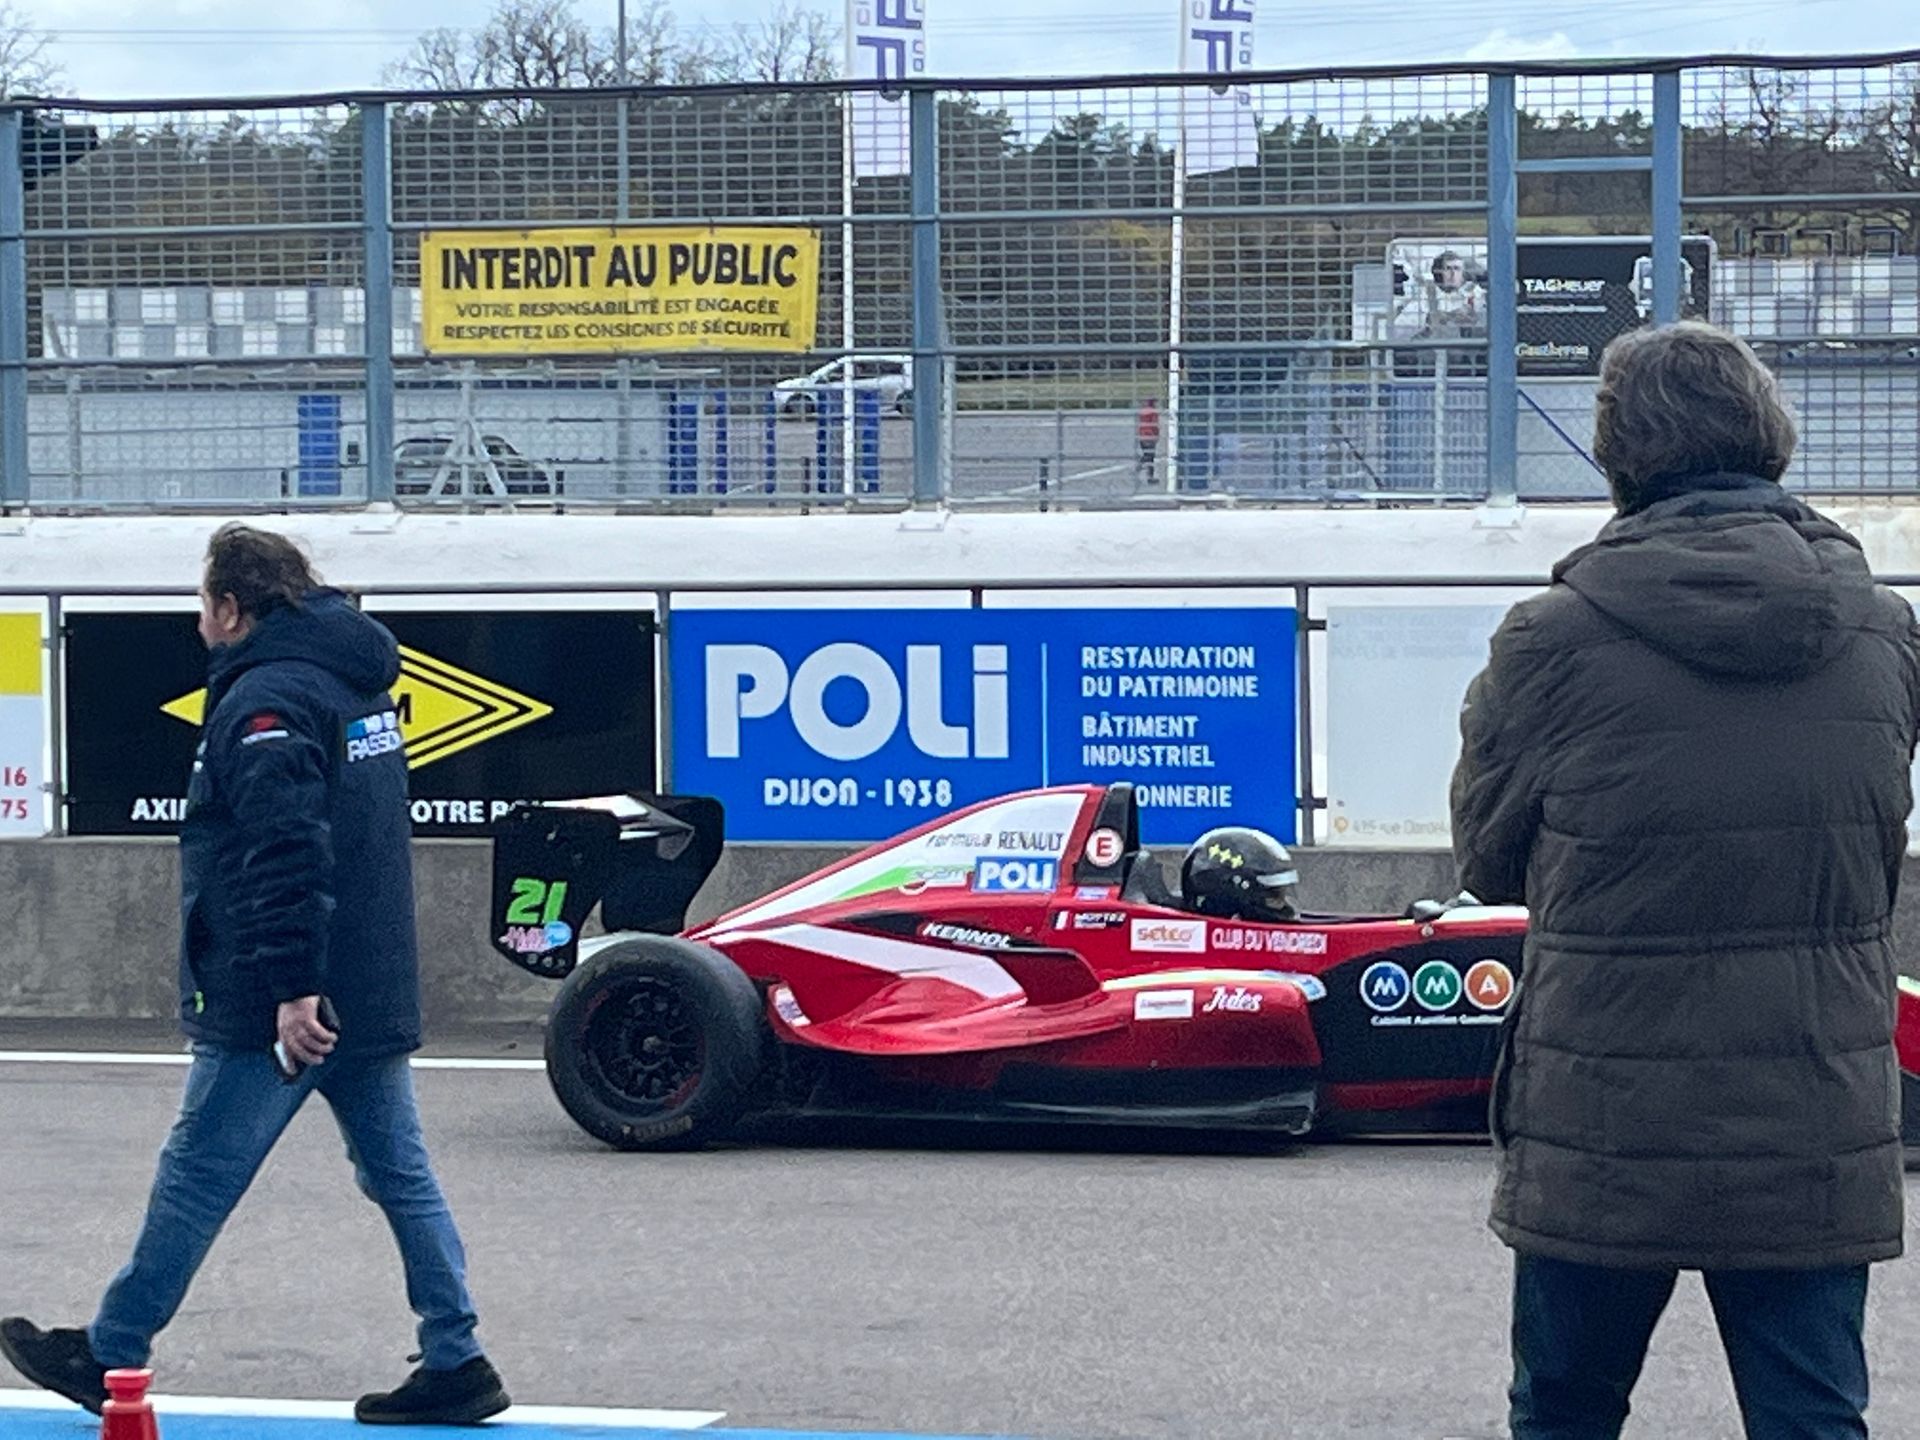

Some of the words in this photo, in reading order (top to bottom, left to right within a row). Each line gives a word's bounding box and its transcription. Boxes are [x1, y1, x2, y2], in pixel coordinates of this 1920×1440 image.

[442, 246, 595, 289] INTERDIT
[606, 245, 656, 287] AU
[669, 243, 798, 287] PUBLIC
[456, 302, 513, 317] VOTRE
[519, 298, 659, 316] RESPONSABILITÉ
[665, 300, 691, 314] EST
[696, 297, 779, 314] ENGAGÉE
[444, 324, 543, 339] RESPECTEZ
[547, 325, 569, 338] LES
[574, 322, 673, 338] CONSIGNES
[677, 321, 697, 335] DE
[702, 319, 790, 338] SÉCURITÉ
[1081, 646, 1255, 669] RESTAURATION
[1081, 676, 1112, 697] DU
[1118, 676, 1259, 697] PATRIMOINE
[1082, 711, 1199, 738] BÂTIMENT
[1082, 745, 1215, 767] INDUSTRIEL
[4, 767, 27, 787] 16
[764, 778, 858, 806] DIJON
[1136, 785, 1232, 807] ONNERIE
[2, 800, 27, 819] 75
[408, 799, 485, 823] OTRE
[998, 831, 1064, 851] RENAULT
[1096, 836, 1112, 857] E
[506, 877, 567, 924] 21
[1212, 928, 1243, 950] CLUB
[1245, 929, 1263, 950] DU
